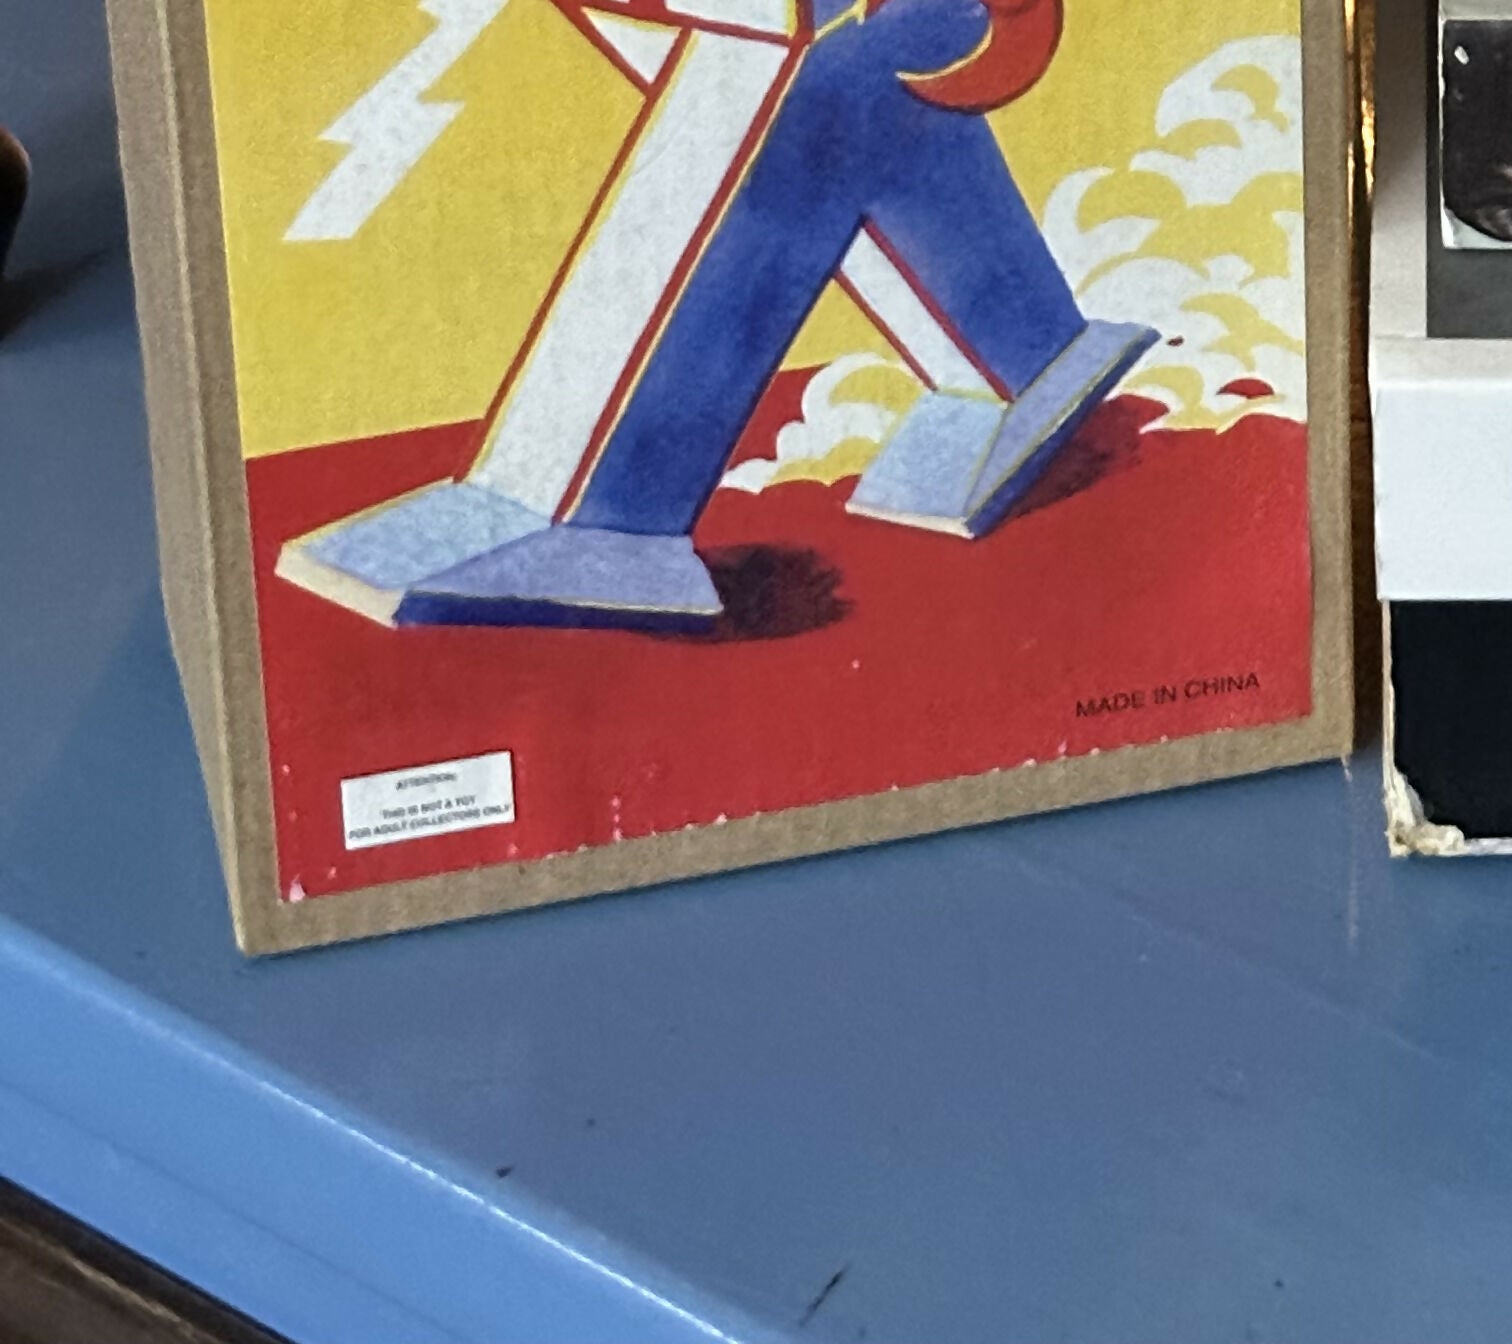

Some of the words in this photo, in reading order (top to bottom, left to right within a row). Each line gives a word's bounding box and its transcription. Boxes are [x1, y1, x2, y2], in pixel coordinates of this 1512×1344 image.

[1075, 689, 1145, 718] MADE
[1153, 684, 1177, 706] IN
[1184, 671, 1260, 699] CHINA
